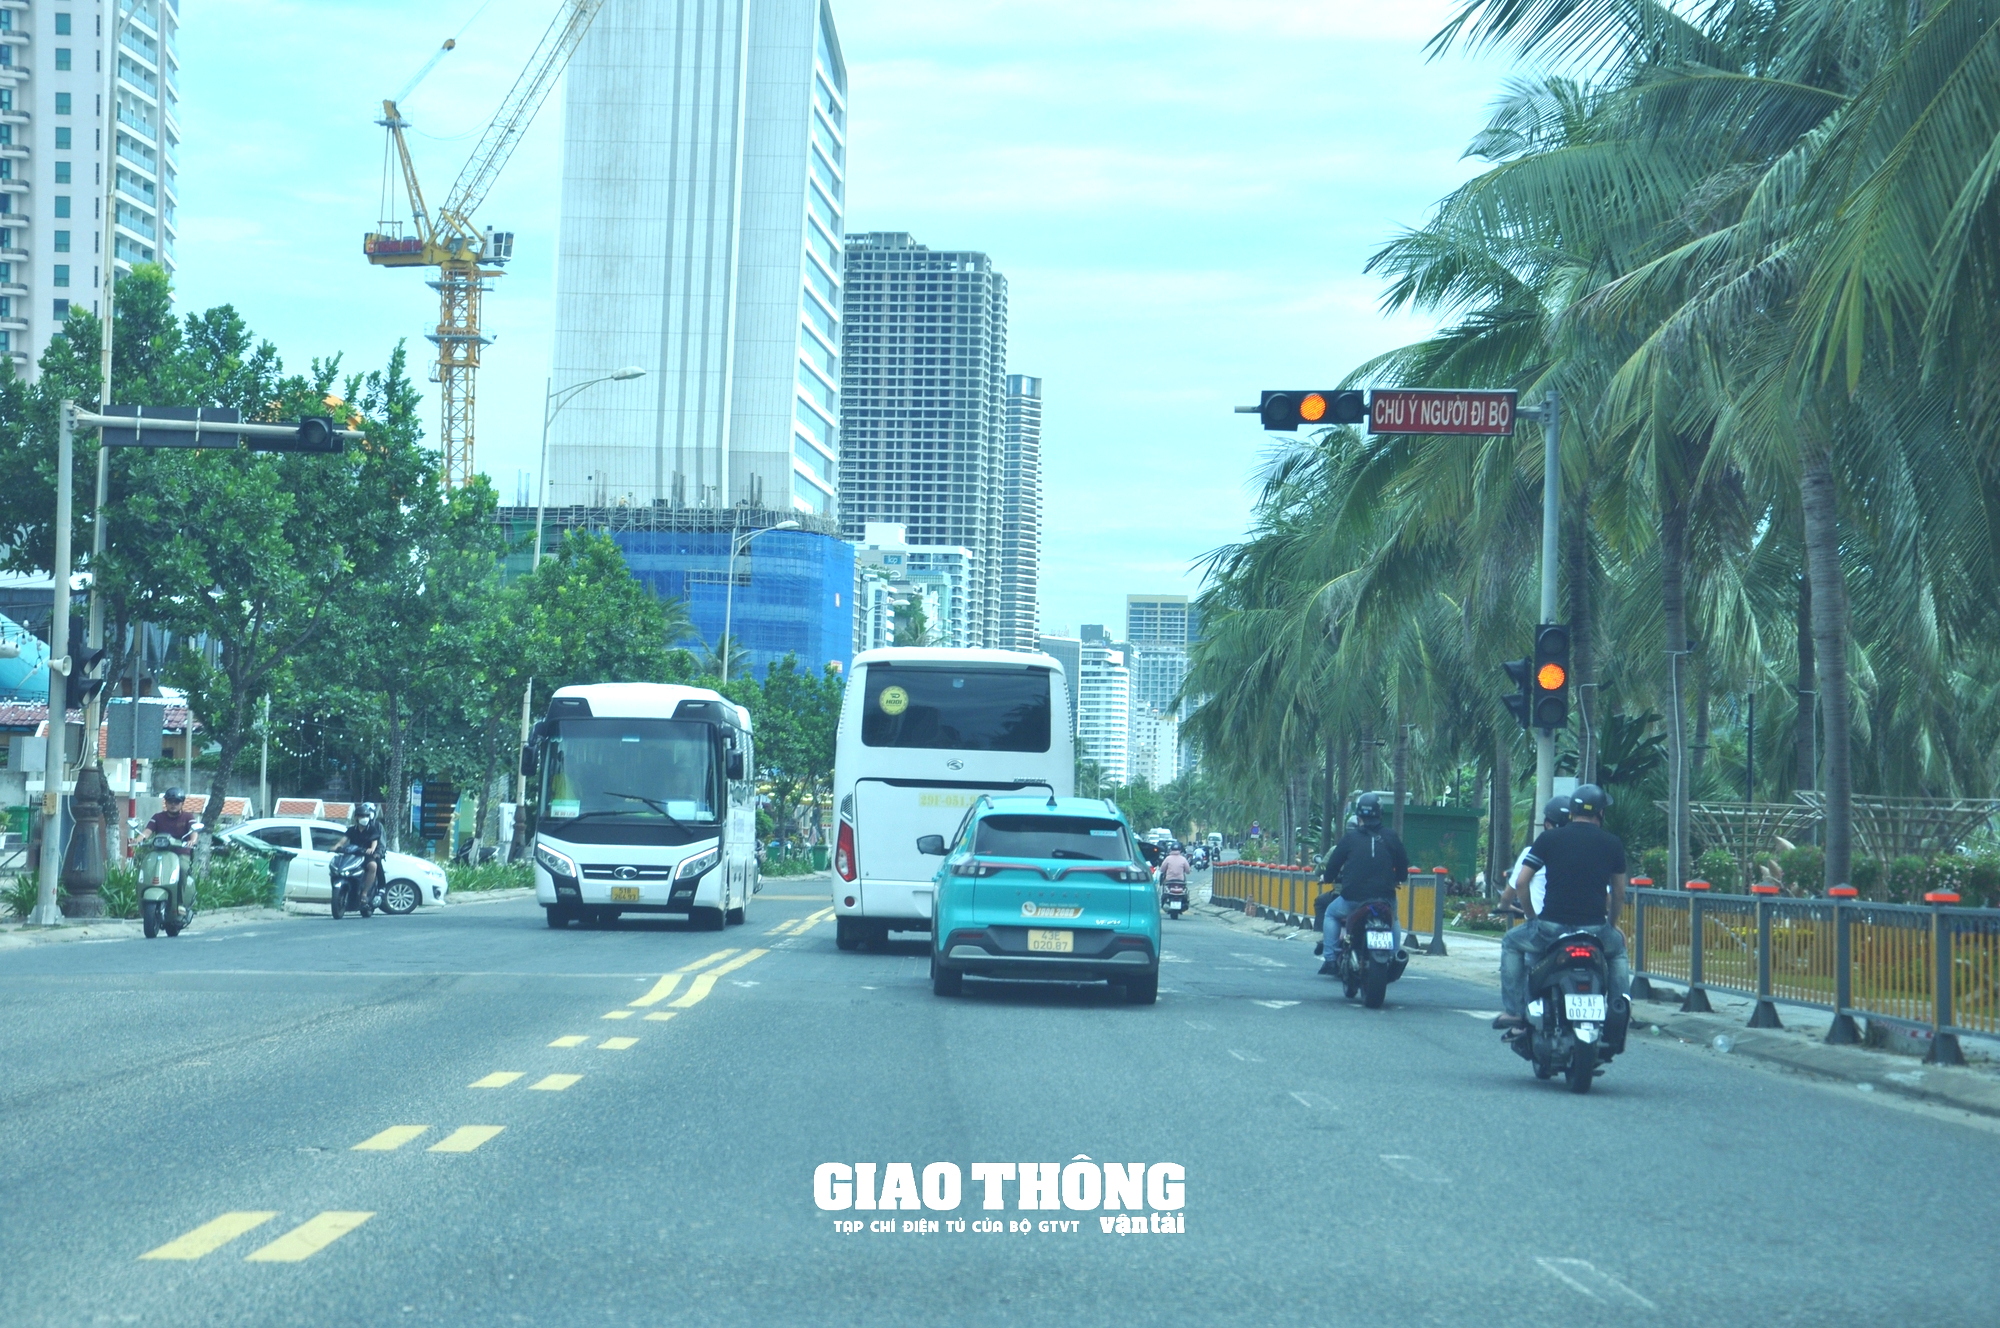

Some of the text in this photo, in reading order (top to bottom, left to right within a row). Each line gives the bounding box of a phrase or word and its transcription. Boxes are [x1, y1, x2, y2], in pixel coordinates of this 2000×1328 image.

[1375, 394, 1509, 432] CHÚ Ý NGƯỜI ĐI BỘ
[1041, 931, 1061, 941] 43E
[1033, 940, 1068, 951] 020.87
